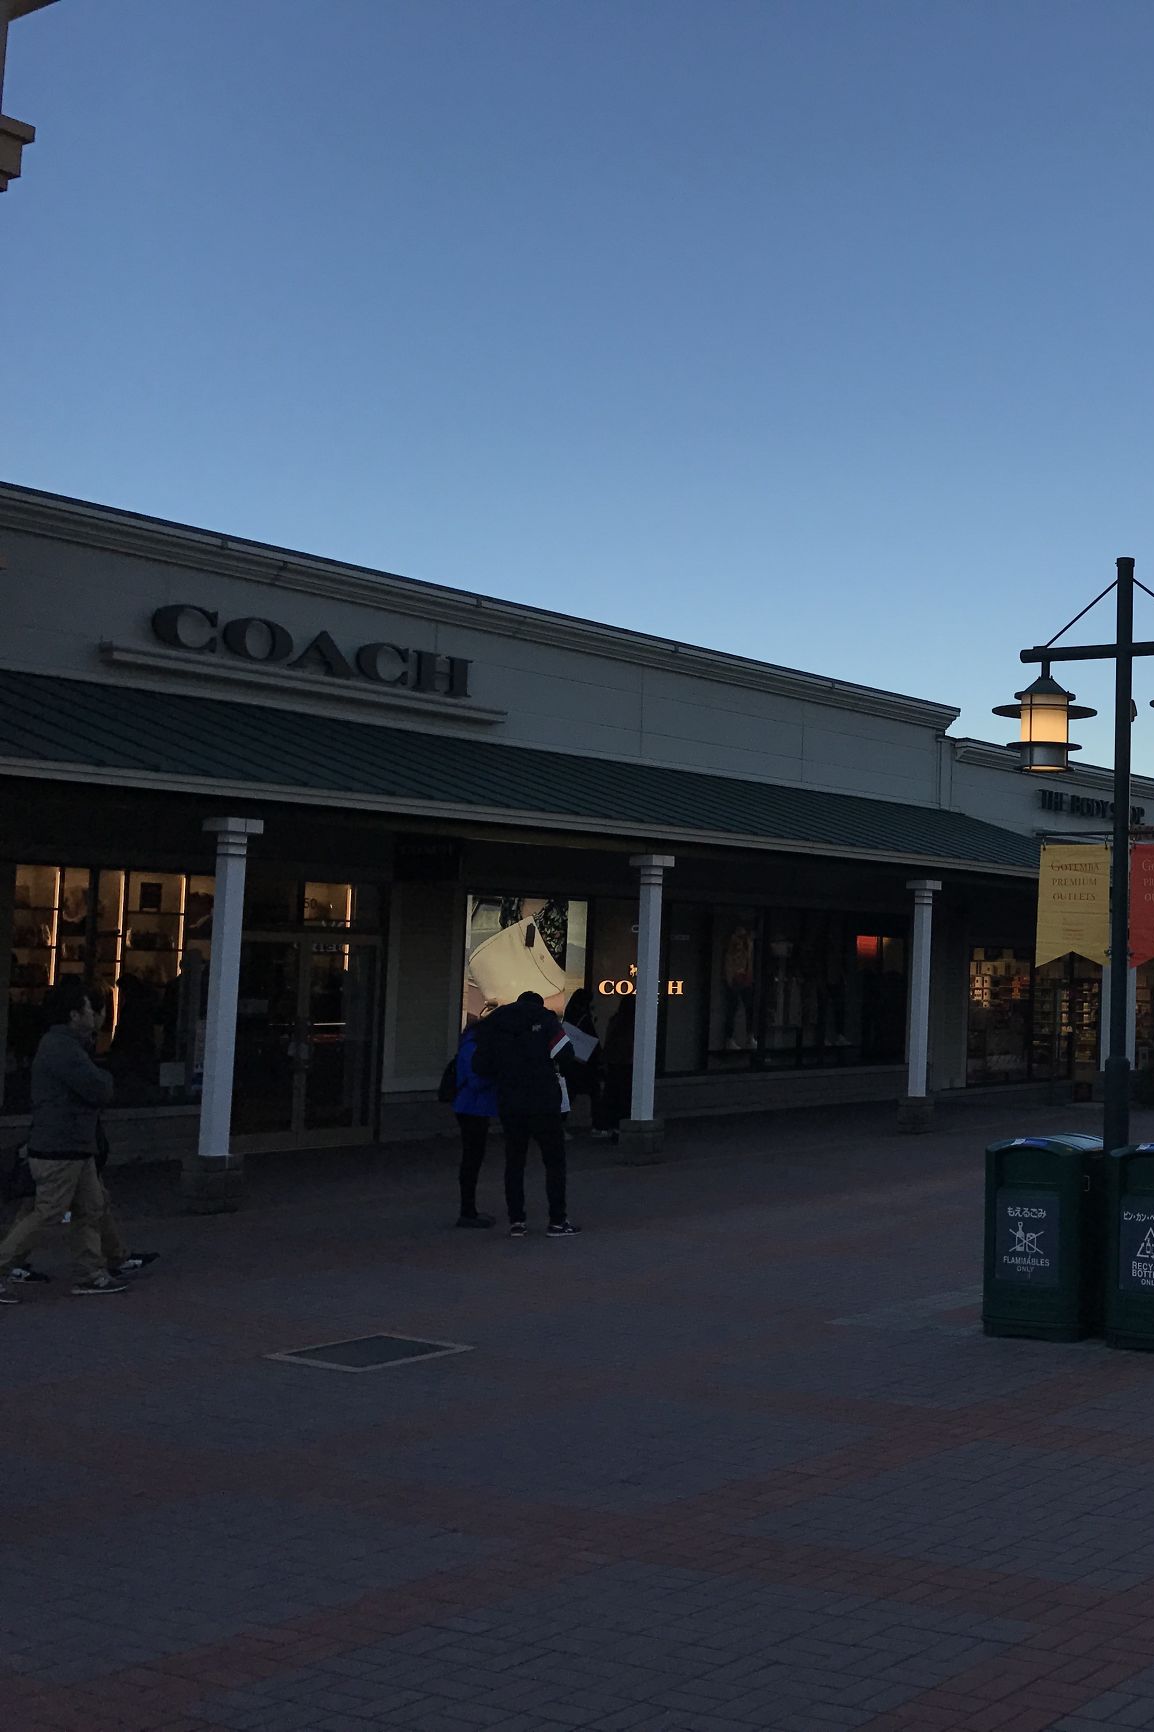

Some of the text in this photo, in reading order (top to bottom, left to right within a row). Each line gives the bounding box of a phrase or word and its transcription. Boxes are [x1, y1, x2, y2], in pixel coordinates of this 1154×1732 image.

[152, 604, 472, 698] COACH
[1052, 878, 1097, 887] PREMIUM
[1053, 891, 1096, 901] OUTLETS
[598, 980, 684, 995] COH
[1007, 1206, 1047, 1219] もえるごみ
[1003, 1255, 1050, 1267] FLAMMABLES
[1016, 1265, 1035, 1273] ONLY
